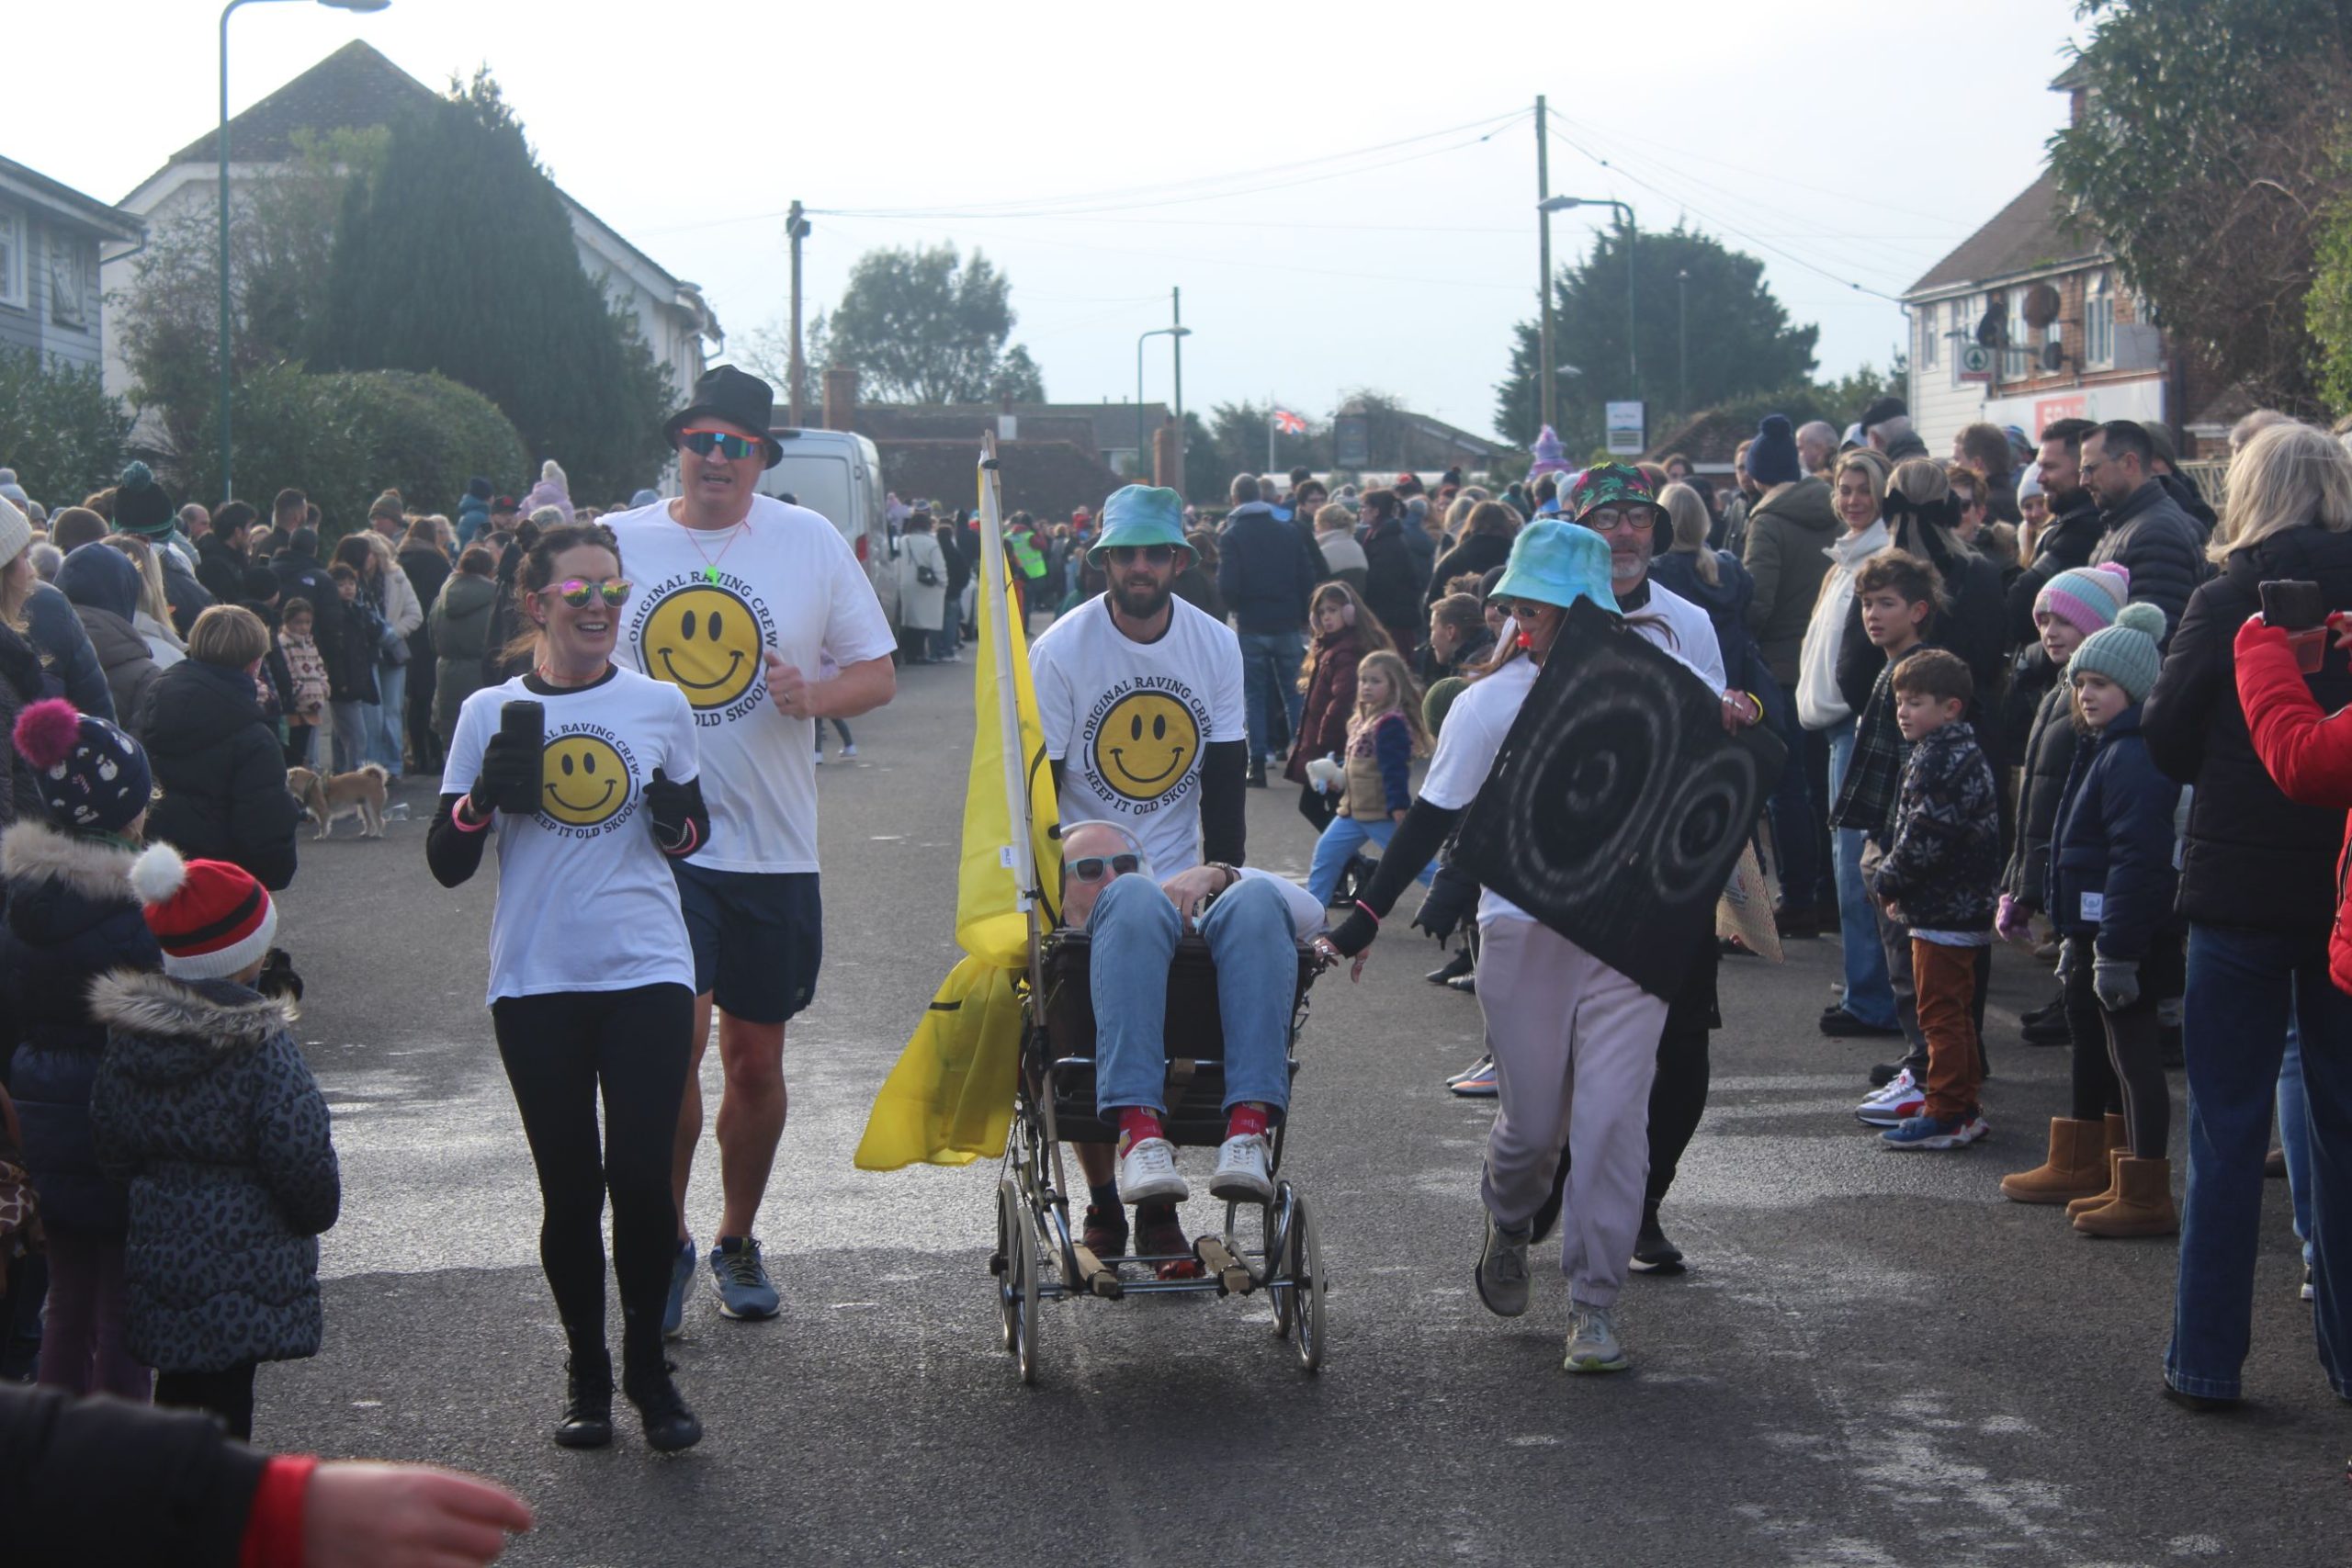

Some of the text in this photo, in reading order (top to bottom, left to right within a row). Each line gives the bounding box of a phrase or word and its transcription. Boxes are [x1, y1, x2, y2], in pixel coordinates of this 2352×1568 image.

[629, 571, 778, 649] ORIGINAL RAVING CREW
[726, 682, 768, 722] SKOOL
[1082, 676, 1213, 741] ORIGINAL RAVING CREW
[560, 723, 616, 741] RAVING
[616, 740, 641, 776] CREW
[1085, 769, 1202, 816] KEEP IT OLD SKOOL
[533, 801, 638, 839] EEP IT OLD SKOOL
